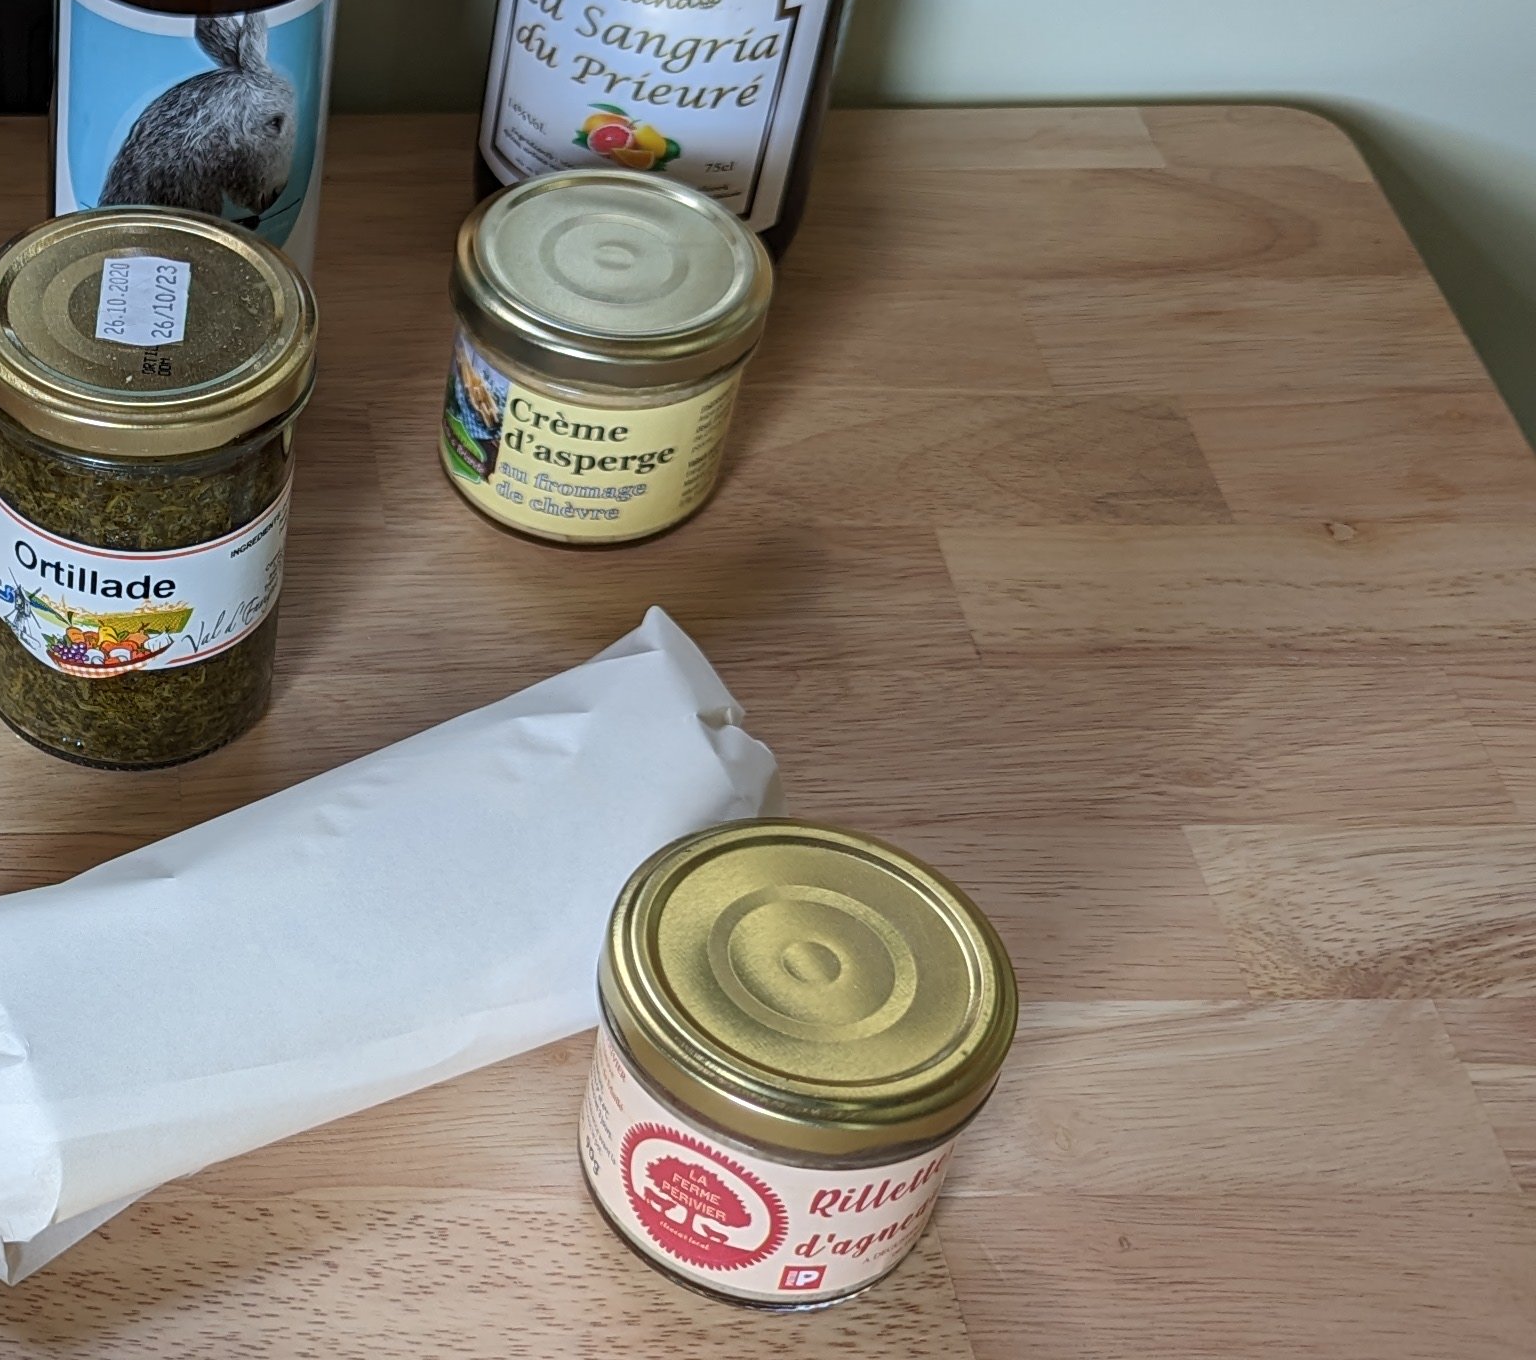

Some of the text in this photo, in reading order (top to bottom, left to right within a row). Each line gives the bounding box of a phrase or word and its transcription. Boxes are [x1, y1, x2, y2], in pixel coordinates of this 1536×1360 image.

[575, 5, 780, 74] Sangria
[516, 23, 763, 109] du Prieuré
[704, 162, 735, 174] 75cl
[104, 263, 130, 335] 26.10.2020
[151, 265, 178, 339] 26/10/23
[142, 345, 159, 375] ORTIL
[510, 397, 629, 442] Crème
[504, 428, 675, 475] d'asperge
[496, 481, 620, 520] de chèvre
[499, 461, 528, 484] au
[534, 472, 647, 502] fromage
[15, 540, 177, 600] Ortillade
[672, 1173, 721, 1205] FERME
[689, 1169, 708, 1187] LA
[662, 1180, 726, 1222] PÉRIVIER
